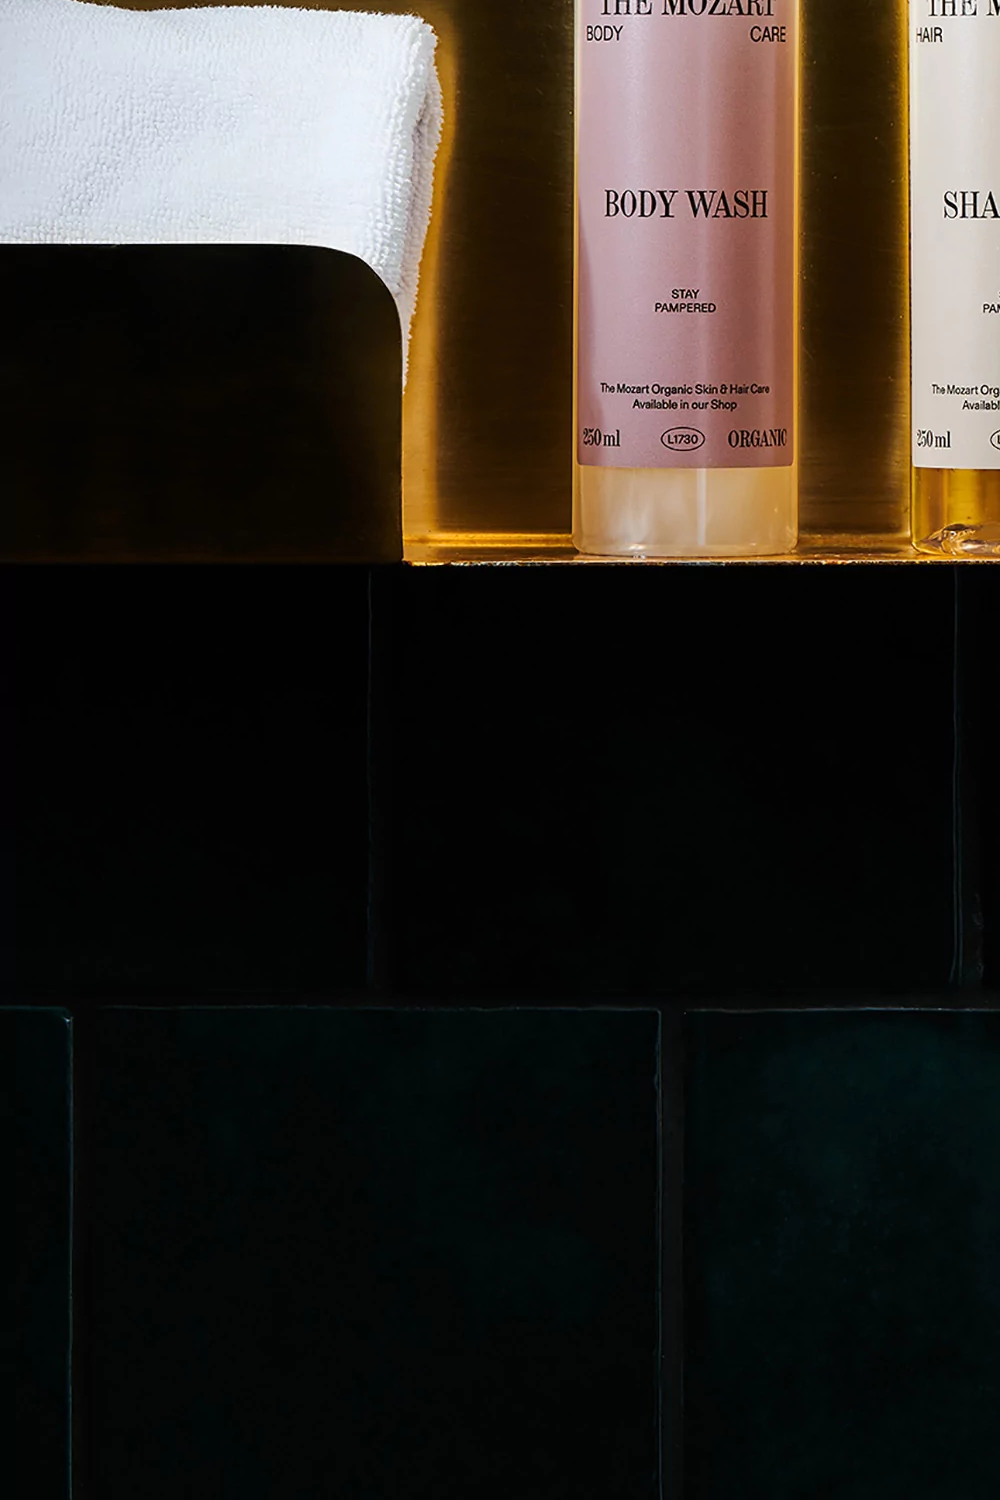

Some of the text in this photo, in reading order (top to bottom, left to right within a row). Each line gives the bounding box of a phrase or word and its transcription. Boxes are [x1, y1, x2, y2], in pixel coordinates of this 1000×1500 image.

[586, 25, 786, 43] BODY CARE
[916, 27, 943, 43] HAIR
[604, 189, 768, 218] BODY WASH
[671, 289, 700, 299] STAY
[654, 303, 716, 313] PAMPERED
[600, 383, 770, 397] The Mozart Organic Skin & Hair Care
[932, 384, 946, 394] The
[947, 384, 979, 395] Mozart
[632, 399, 737, 412] Available in our Shop
[667, 434, 698, 444] L1730
[728, 428, 787, 448] ORGANIC
